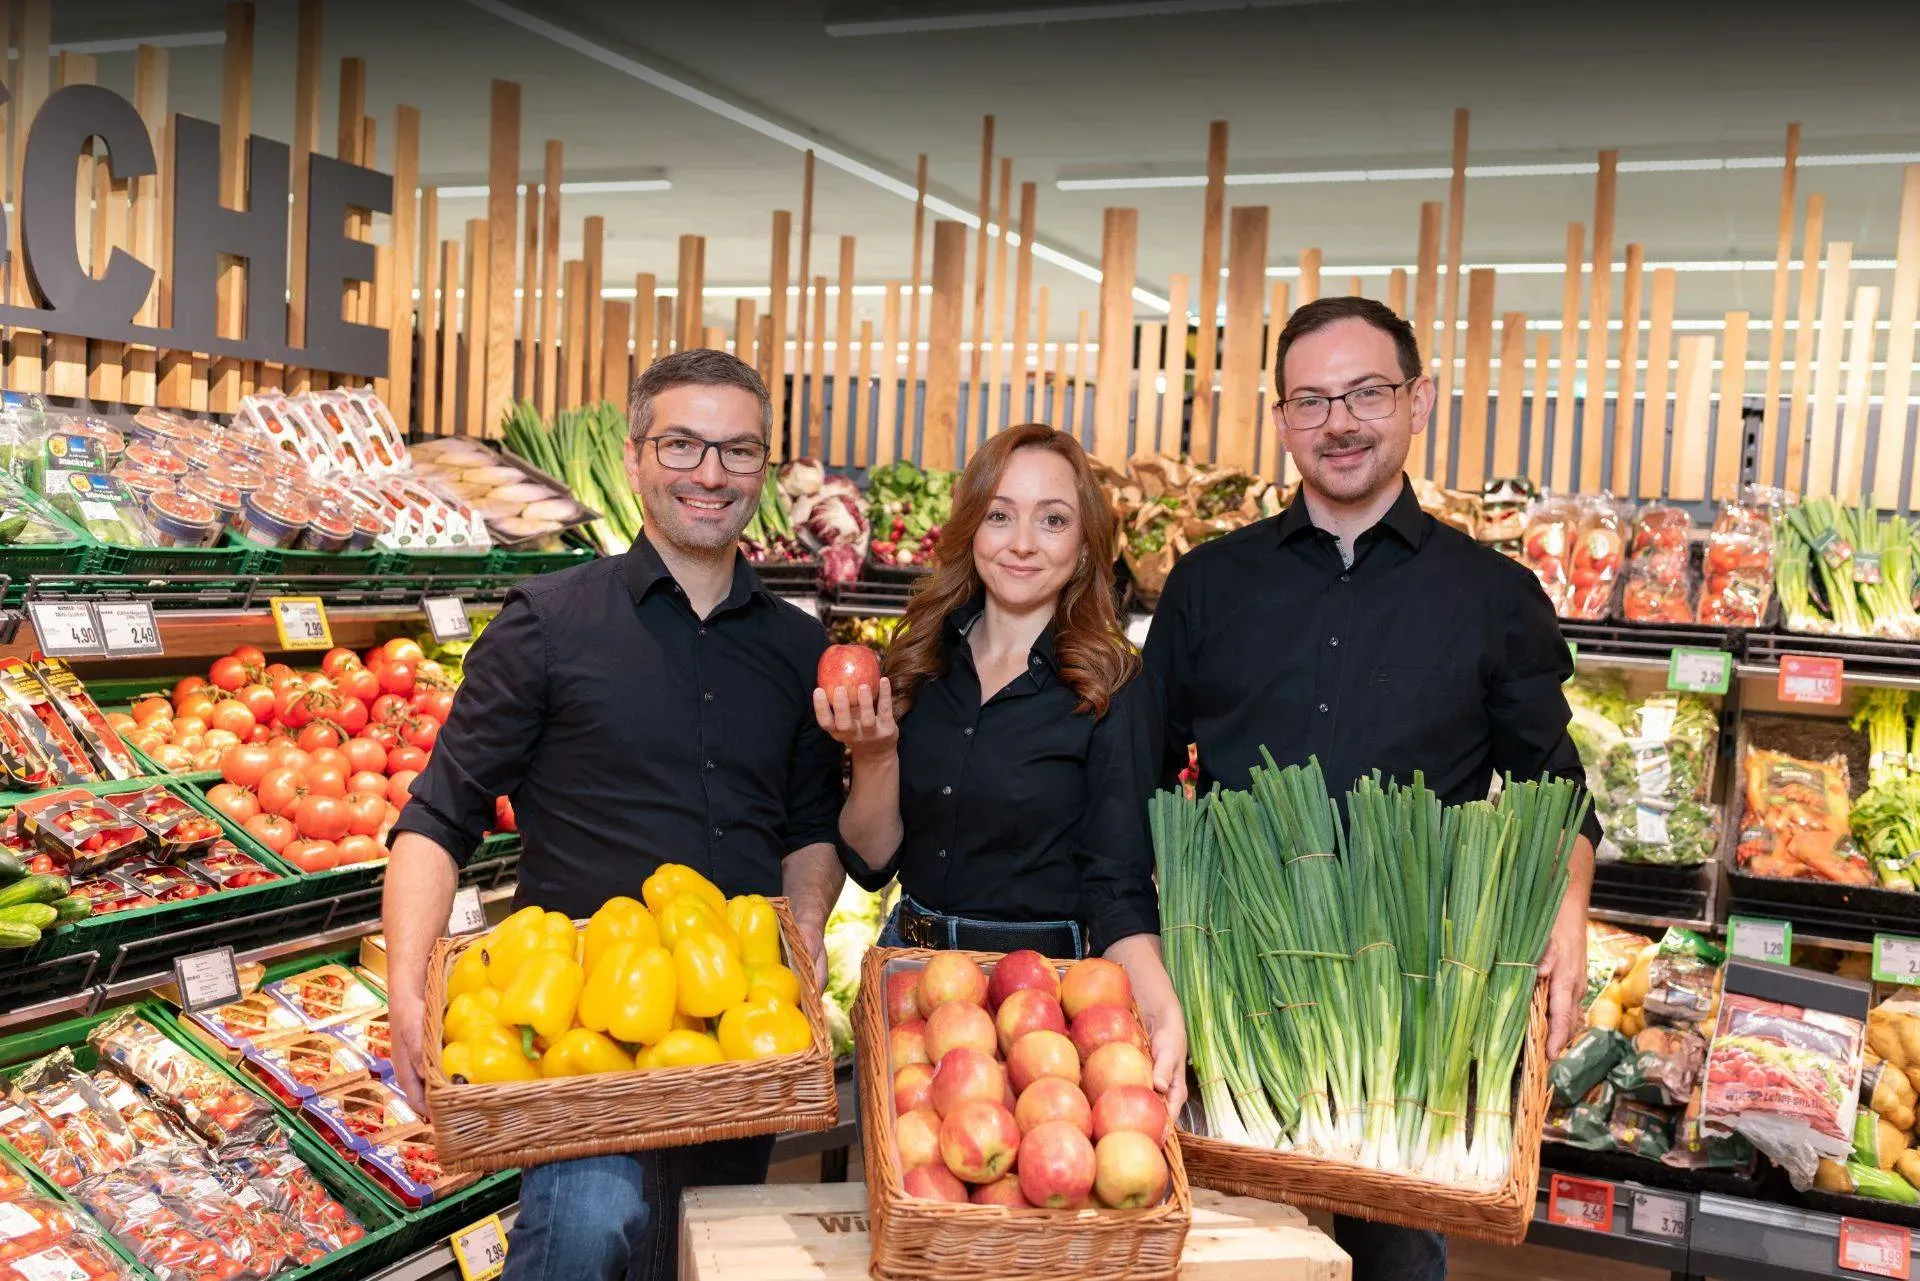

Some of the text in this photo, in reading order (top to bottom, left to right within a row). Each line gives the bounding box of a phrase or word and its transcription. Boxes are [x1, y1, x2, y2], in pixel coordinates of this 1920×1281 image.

[0, 80, 394, 378] CHE
[72, 627, 96, 644] 4.90
[131, 627, 155, 644] 2.49
[304, 621, 325, 637] 2.99
[1763, 941, 1783, 956] 1.29
[1909, 960, 1920, 974] 2.
[1582, 1203, 1606, 1220] 2.49
[1661, 1218, 1684, 1234] 3.79
[485, 1242, 505, 1264] 2.99
[1880, 1248, 1902, 1265] 1.99
